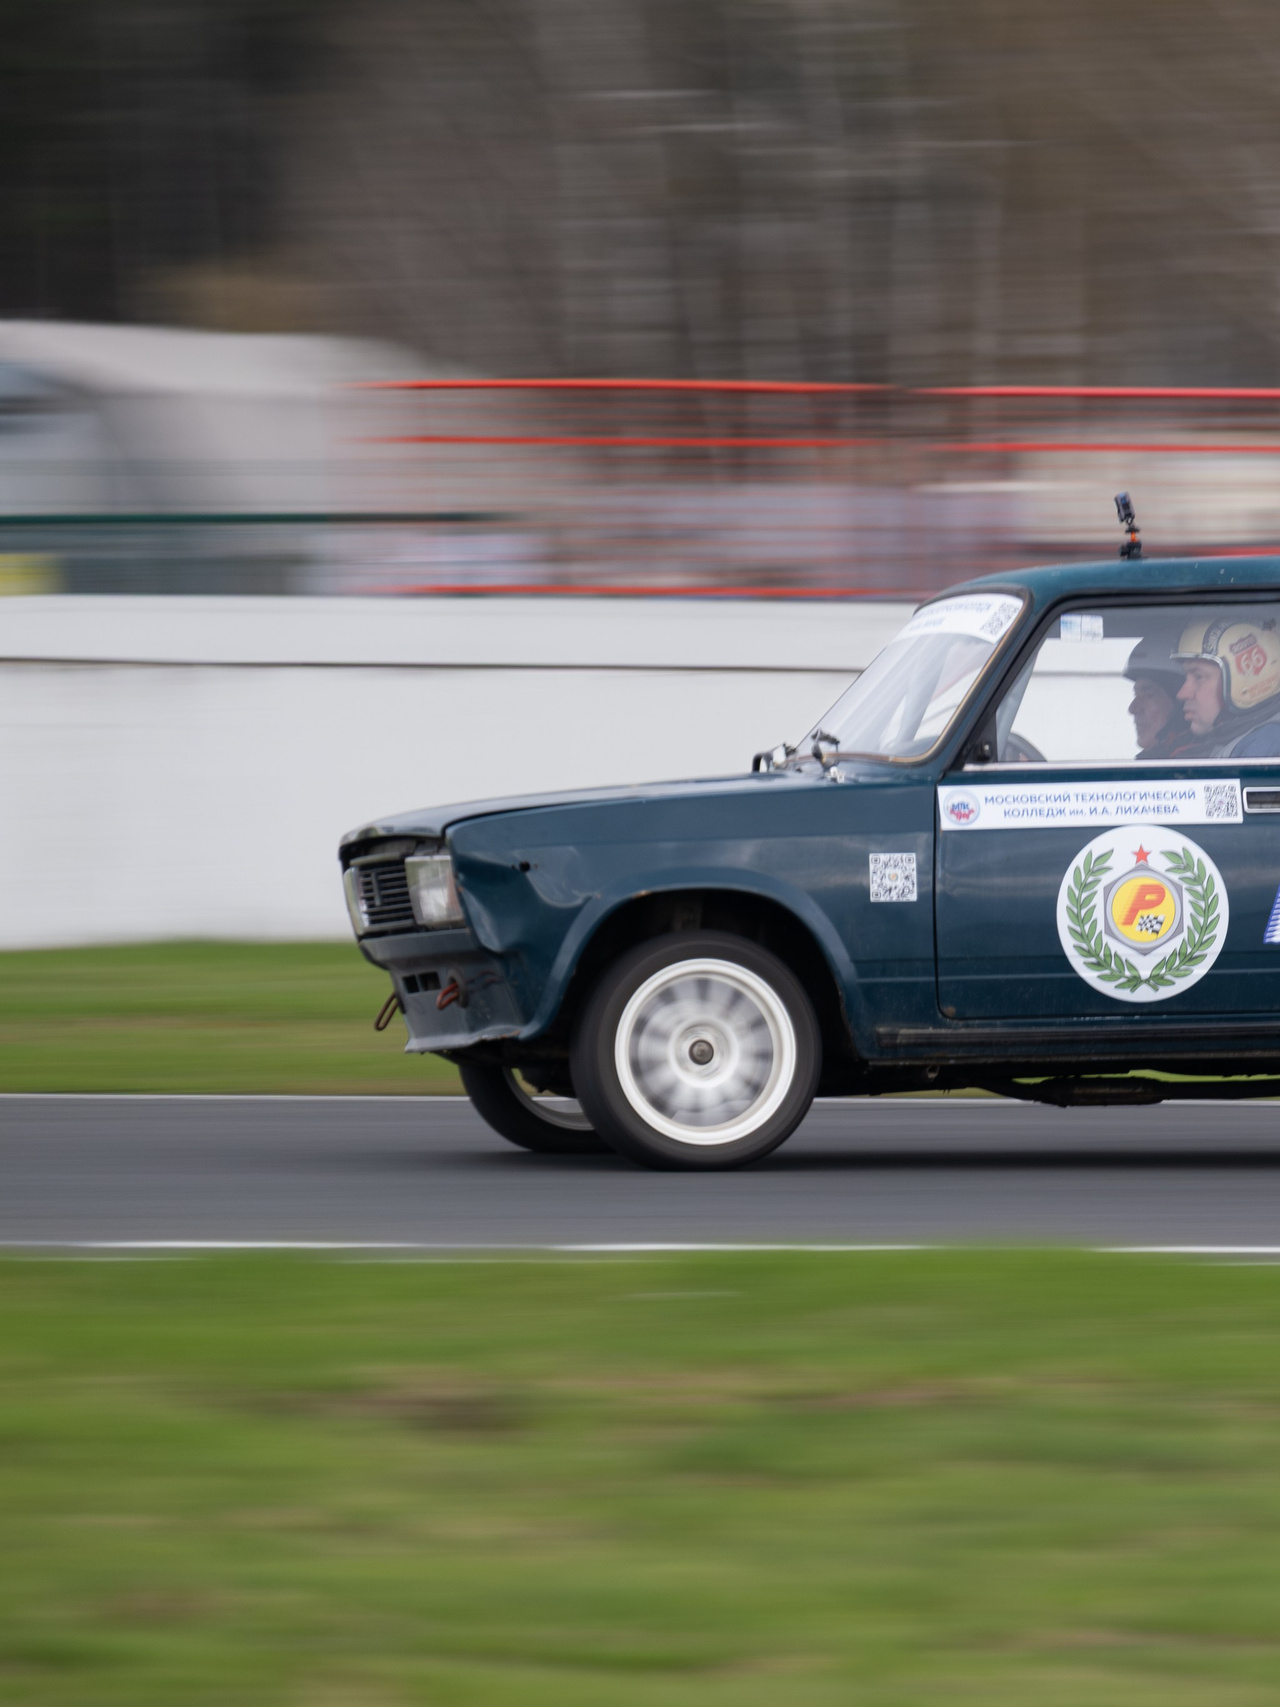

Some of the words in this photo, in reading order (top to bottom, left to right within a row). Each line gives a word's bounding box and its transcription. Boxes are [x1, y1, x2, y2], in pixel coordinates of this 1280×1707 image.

[1240, 648, 1265, 676] 66
[984, 790, 1071, 805] МОСКОВСКИЙ
[1074, 788, 1196, 803] ТЕХНОЛОГИЧЕСКИЙ
[1003, 807, 1066, 818] КОЛЛЕДЖ
[1115, 804, 1180, 816] ЛИХАЧЕВА
